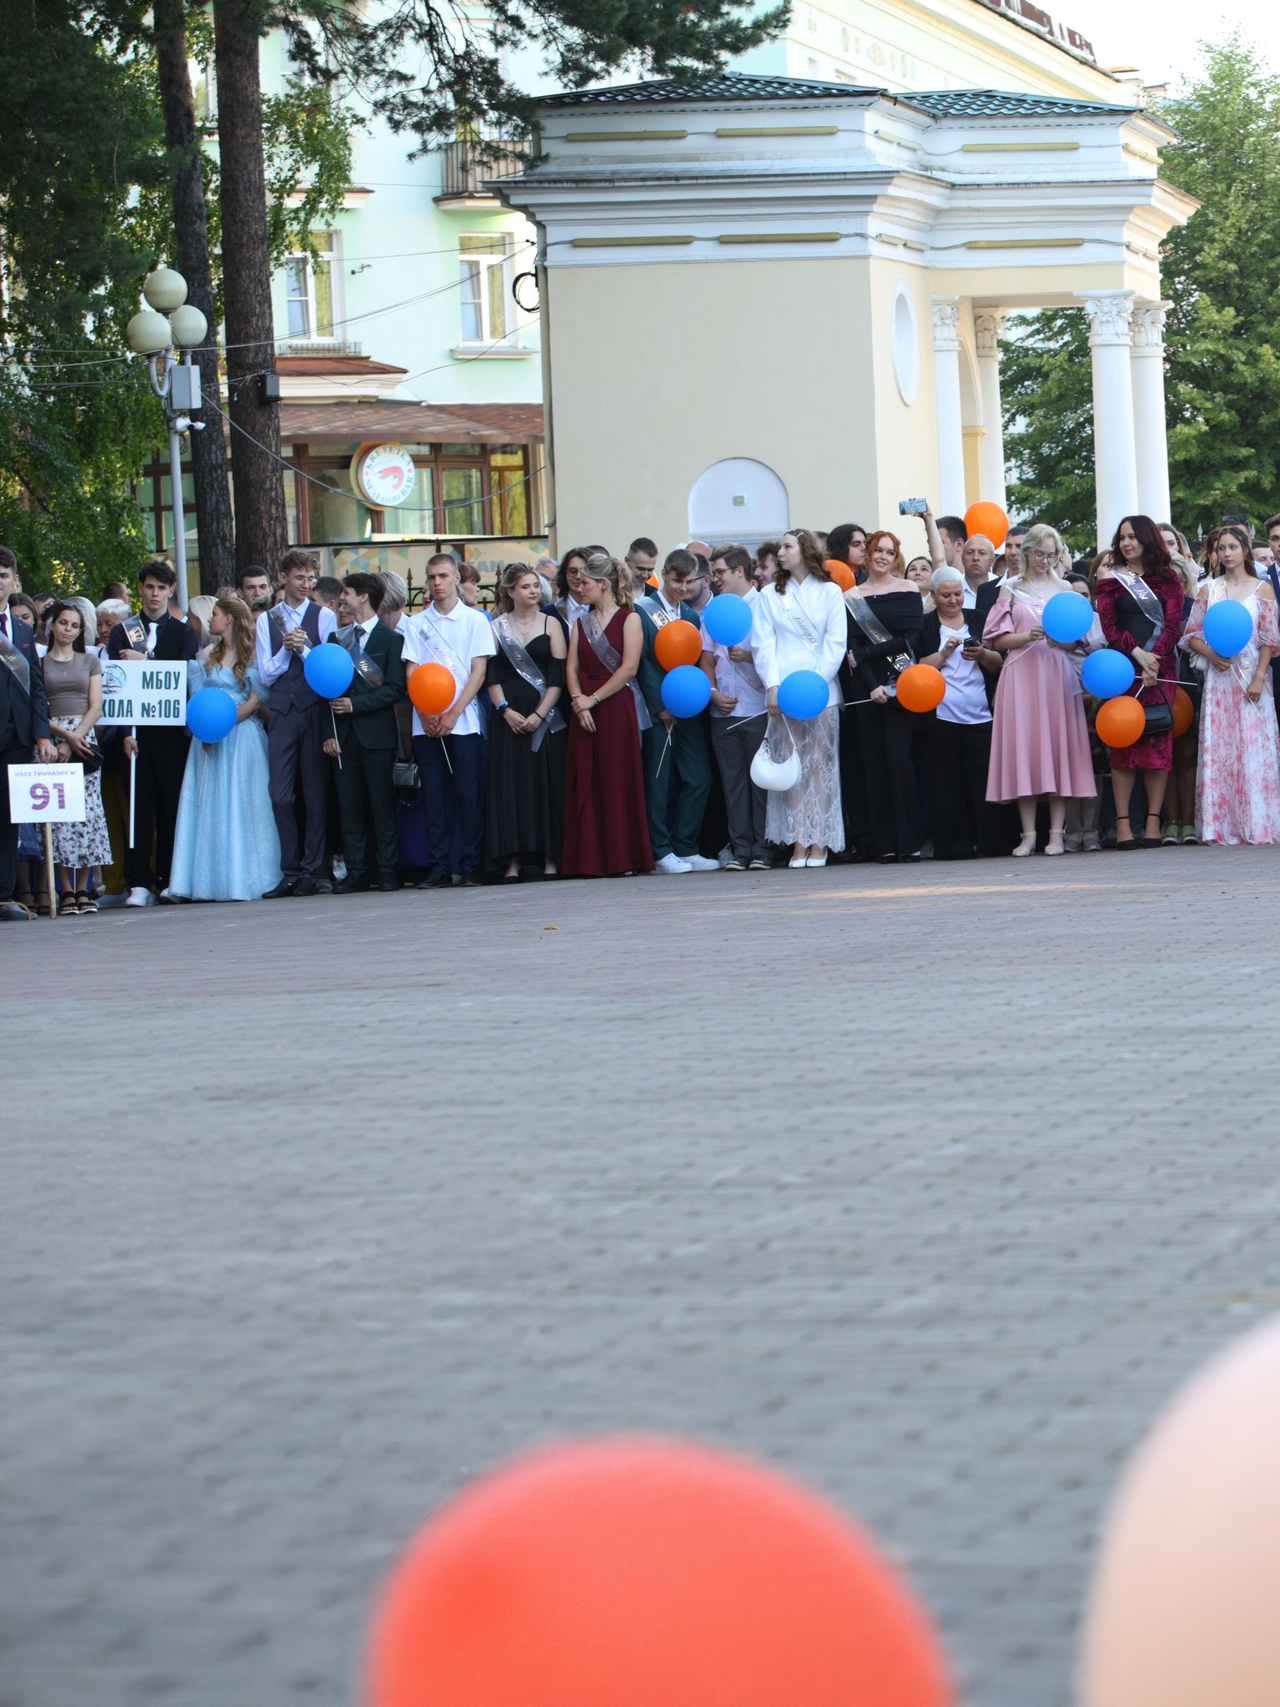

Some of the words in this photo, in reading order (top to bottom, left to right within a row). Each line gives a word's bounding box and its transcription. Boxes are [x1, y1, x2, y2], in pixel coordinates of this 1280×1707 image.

[400, 476, 414, 497] BAR
[142, 671, 181, 690] МБОУ
[141, 699, 180, 719] №106
[29, 782, 66, 810] 91
